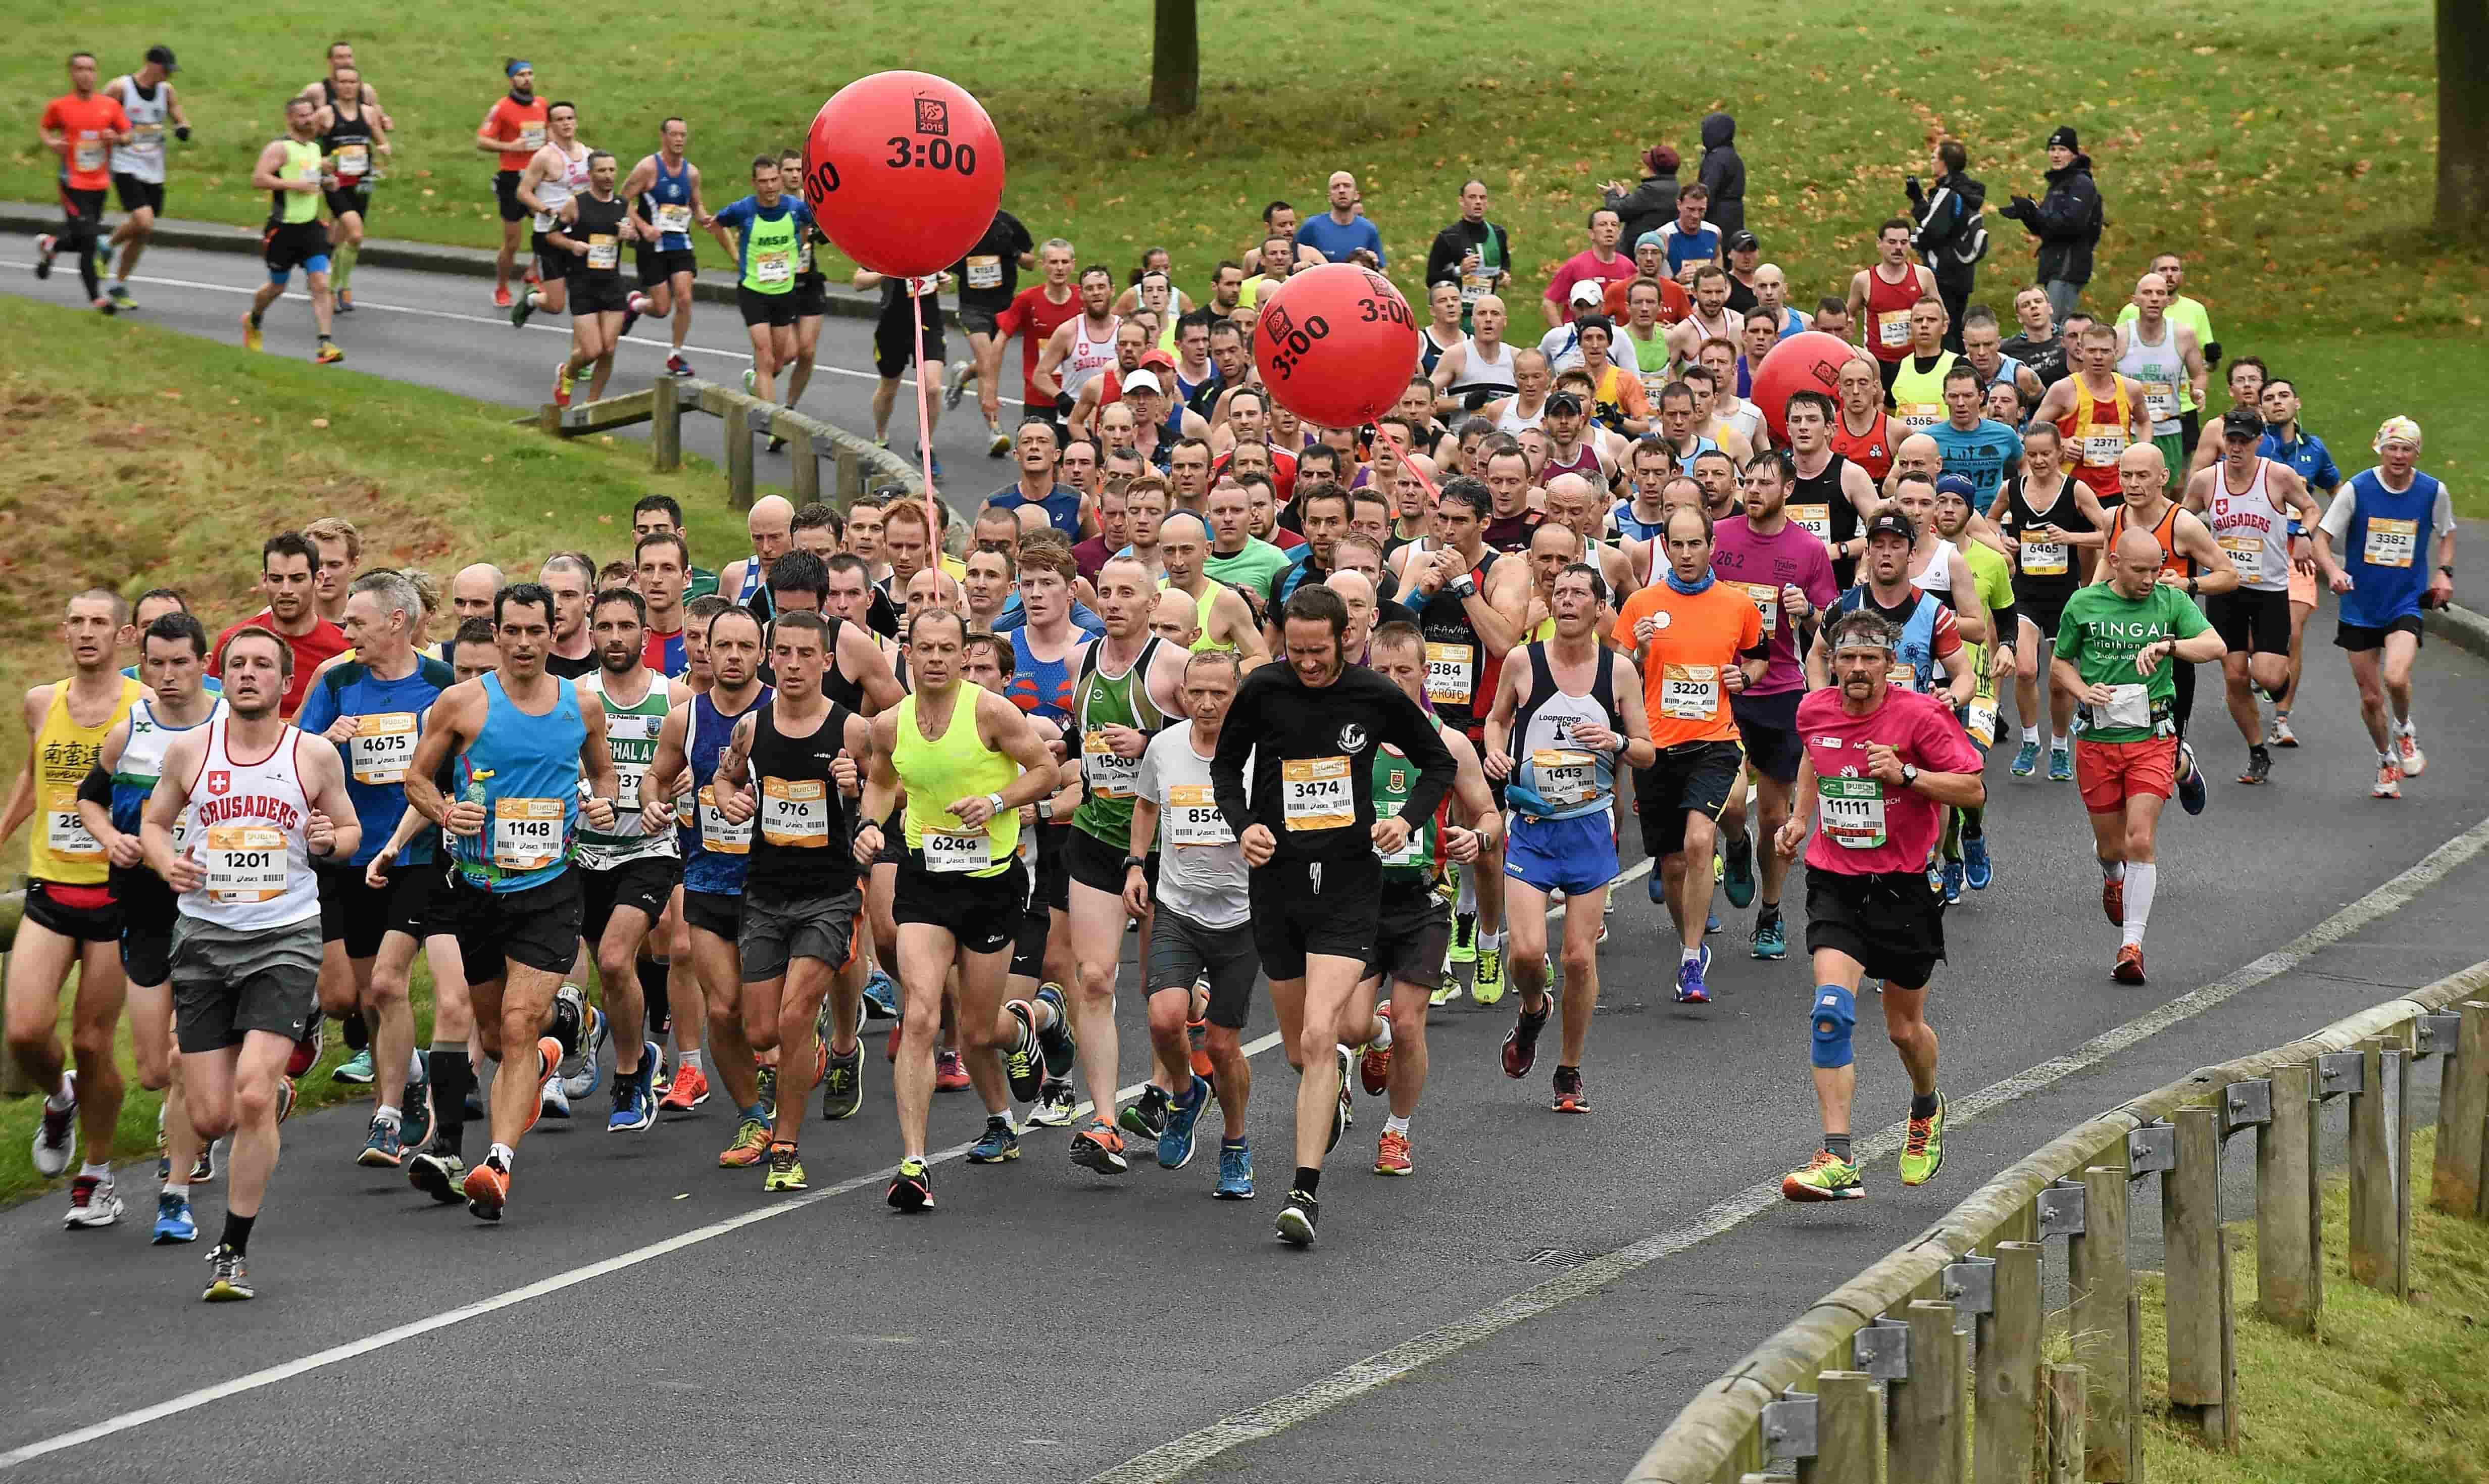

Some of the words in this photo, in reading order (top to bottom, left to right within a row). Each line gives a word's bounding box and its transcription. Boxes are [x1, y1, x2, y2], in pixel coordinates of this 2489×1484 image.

[920, 123, 944, 132] 2015
[886, 136, 976, 176] 3:00
[807, 161, 840, 216] :00
[758, 236, 788, 246] MSB
[1357, 299, 1415, 331] 3:00
[1272, 315, 1329, 380] 3:00
[2145, 395, 2164, 404] 124
[2094, 438, 2118, 447] 2371
[2375, 533, 2407, 545] 3382
[2029, 543, 2060, 554] 6465
[1717, 550, 1745, 569] 26.2
[2088, 621, 2174, 637] FINGAL
[1672, 682, 1709, 695] 3220
[1539, 714, 1582, 724] Loopgroep
[363, 735, 406, 752] 4675
[609, 741, 637, 761] HAL
[617, 774, 643, 788] 37
[1546, 767, 1583, 782] 1413
[1295, 780, 1340, 798] 3474
[200, 795, 298, 829] CRUSADERS
[778, 801, 809, 816] 976
[1827, 800, 1870, 815] 11111
[60, 814, 83, 829] 28
[1188, 809, 1222, 823] 854
[509, 821, 550, 836] 1148
[932, 836, 978, 851] 6244
[225, 852, 270, 868] 1201
